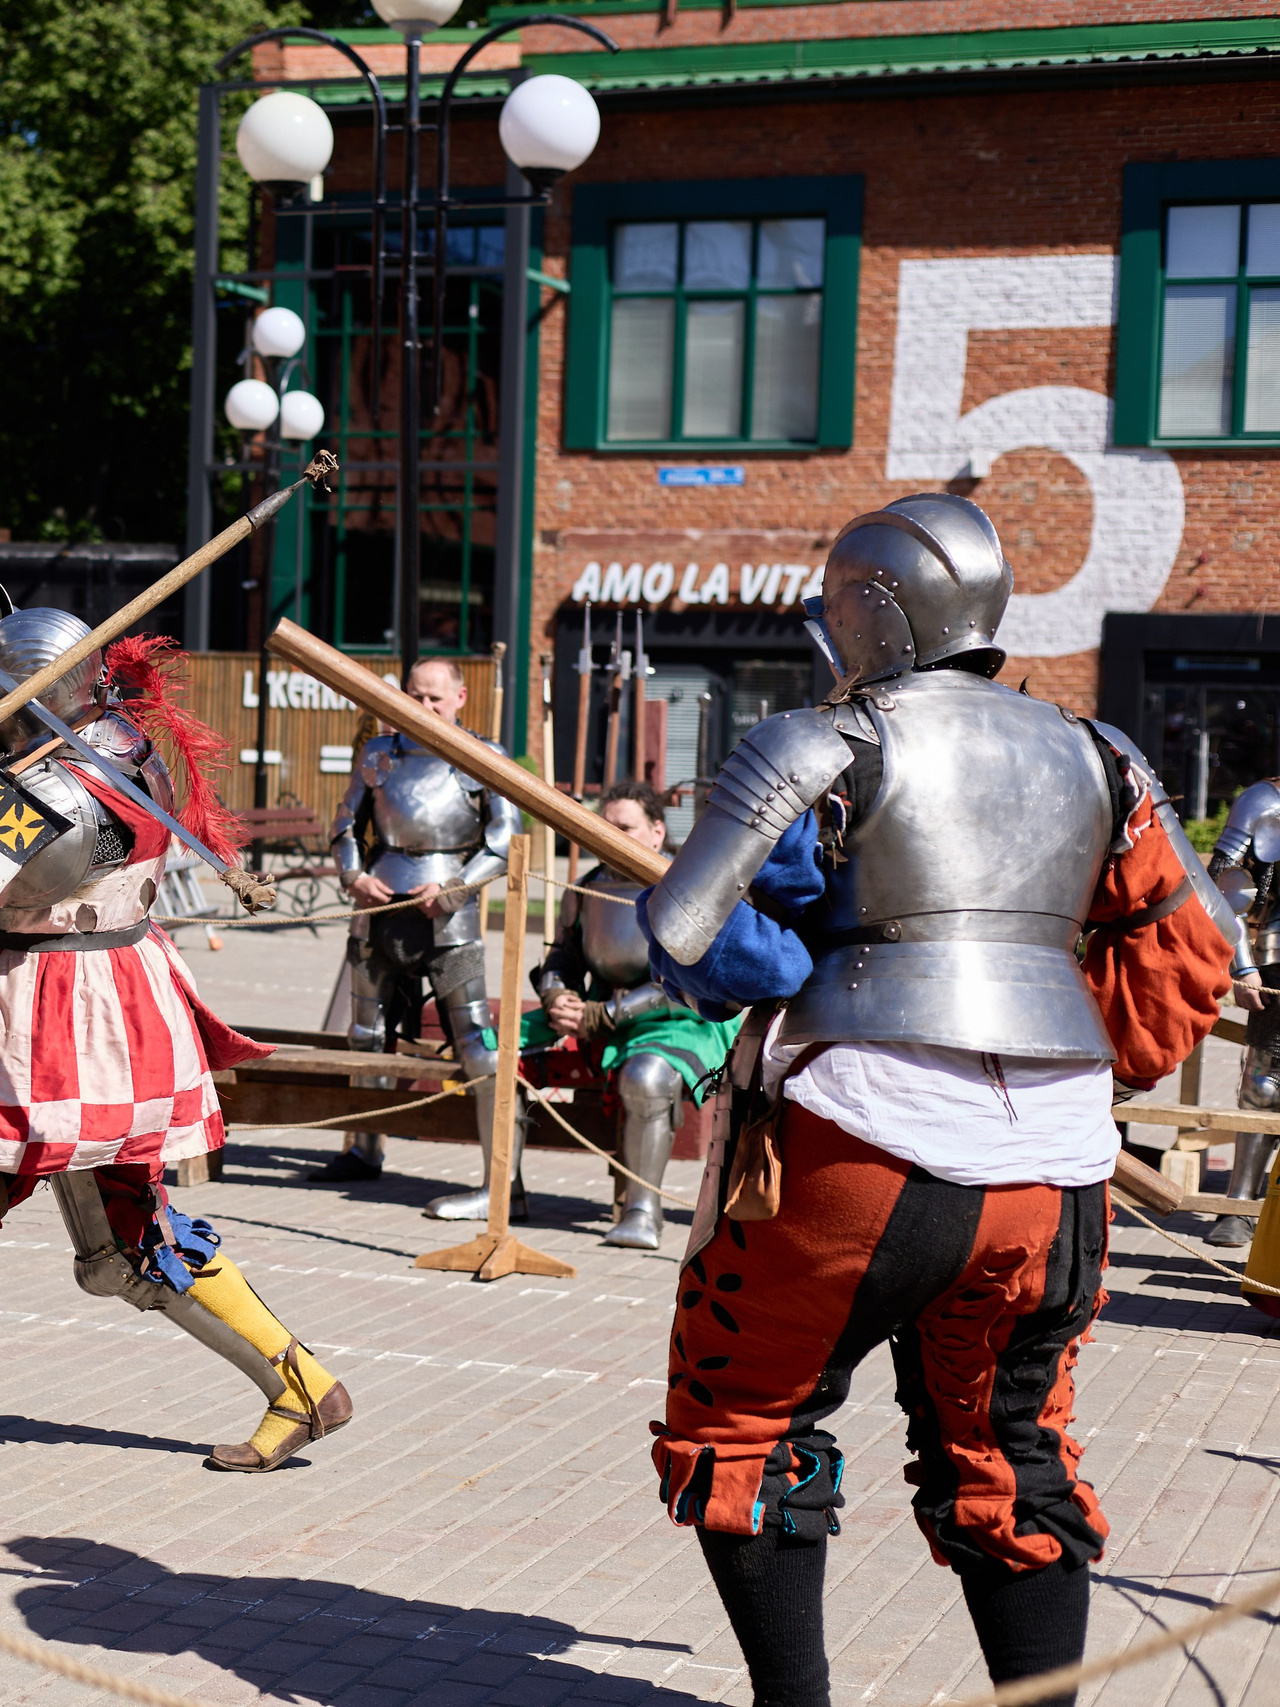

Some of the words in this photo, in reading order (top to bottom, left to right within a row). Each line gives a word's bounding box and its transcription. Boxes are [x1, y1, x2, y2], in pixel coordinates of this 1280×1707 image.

[887, 255, 1184, 657] 5
[571, 562, 675, 603] AMO
[678, 563, 730, 605] LA
